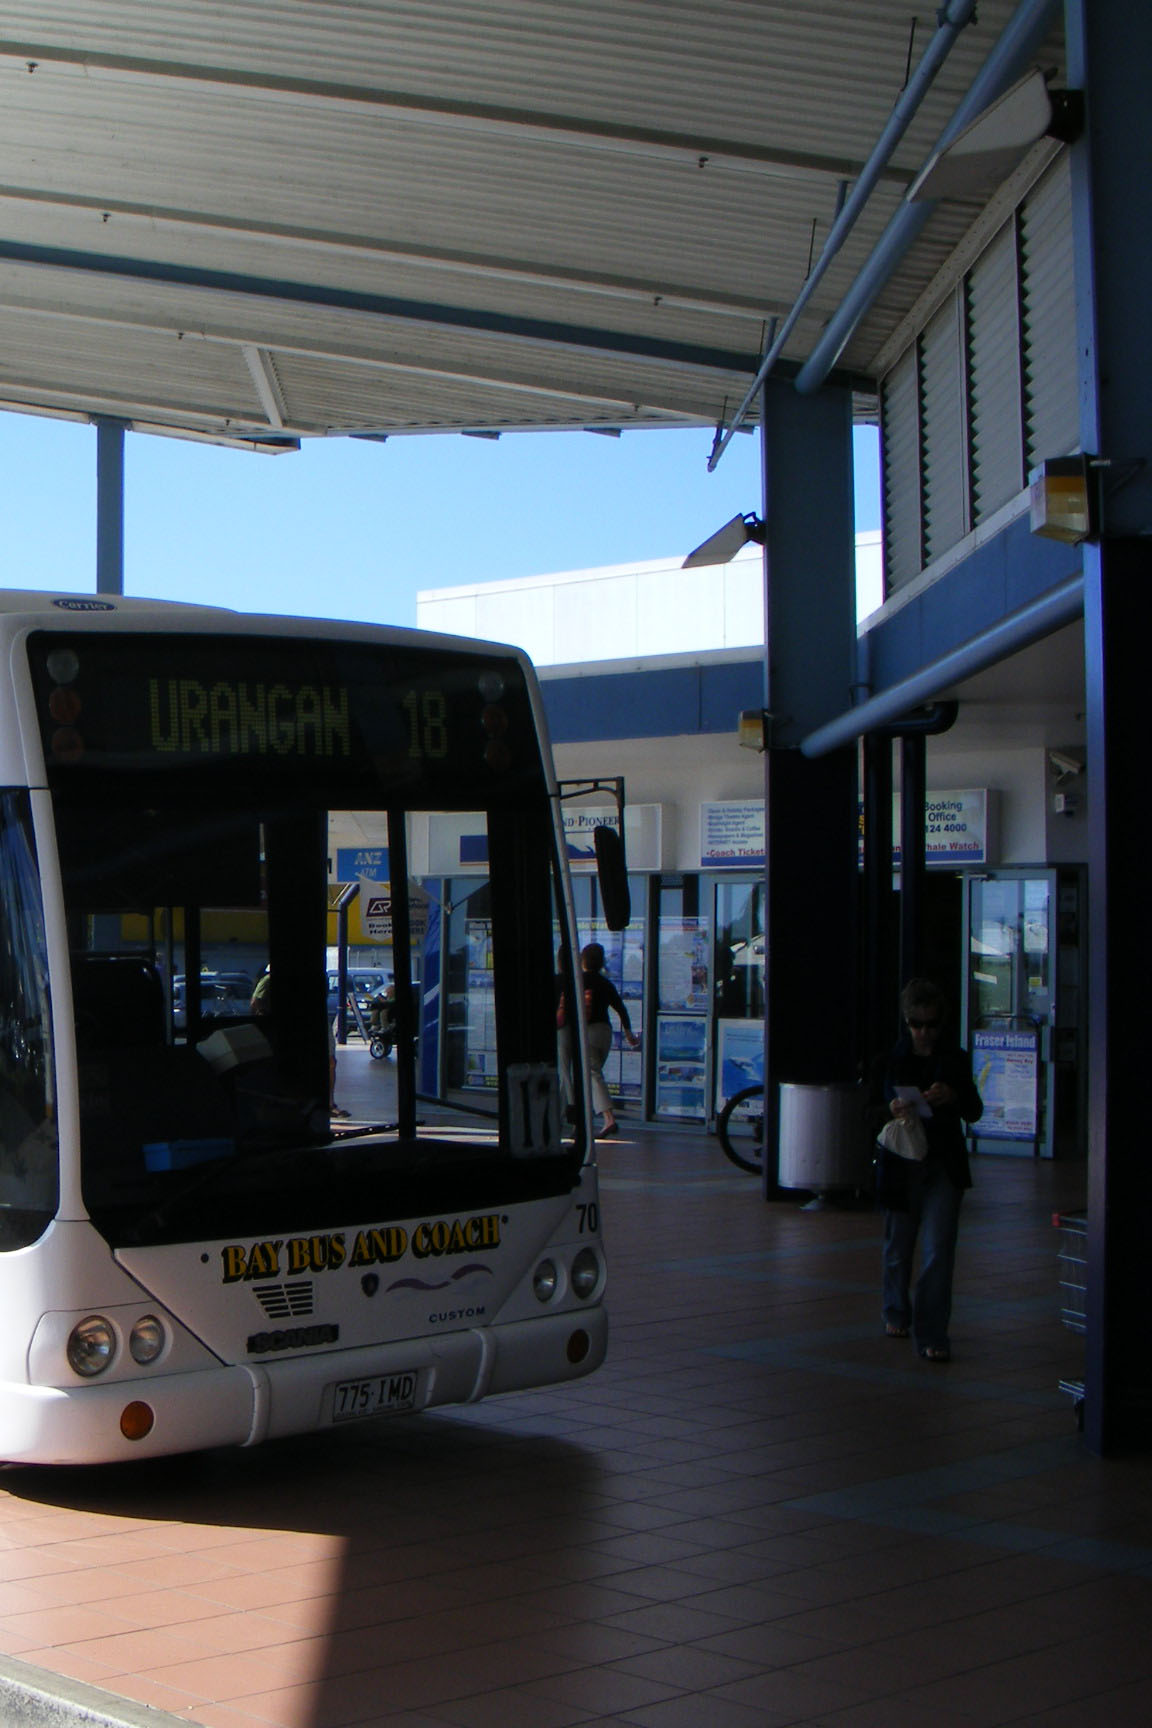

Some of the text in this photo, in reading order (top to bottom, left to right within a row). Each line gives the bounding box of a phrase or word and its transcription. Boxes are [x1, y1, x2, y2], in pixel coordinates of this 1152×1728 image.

[148, 678, 448, 759] URANGAN 18
[928, 812, 956, 822] Office
[944, 823, 967, 832] 4000
[710, 849, 735, 858] Coach
[926, 842, 979, 852] hale Watch
[354, 851, 383, 865] ANZ
[975, 1033, 1036, 1049] Fraser Island
[575, 1202, 598, 1235] 70
[222, 1214, 502, 1284] BAY BUS AND COACH
[428, 1306, 486, 1323] CUSTOM
[254, 1325, 333, 1353] SCANIA
